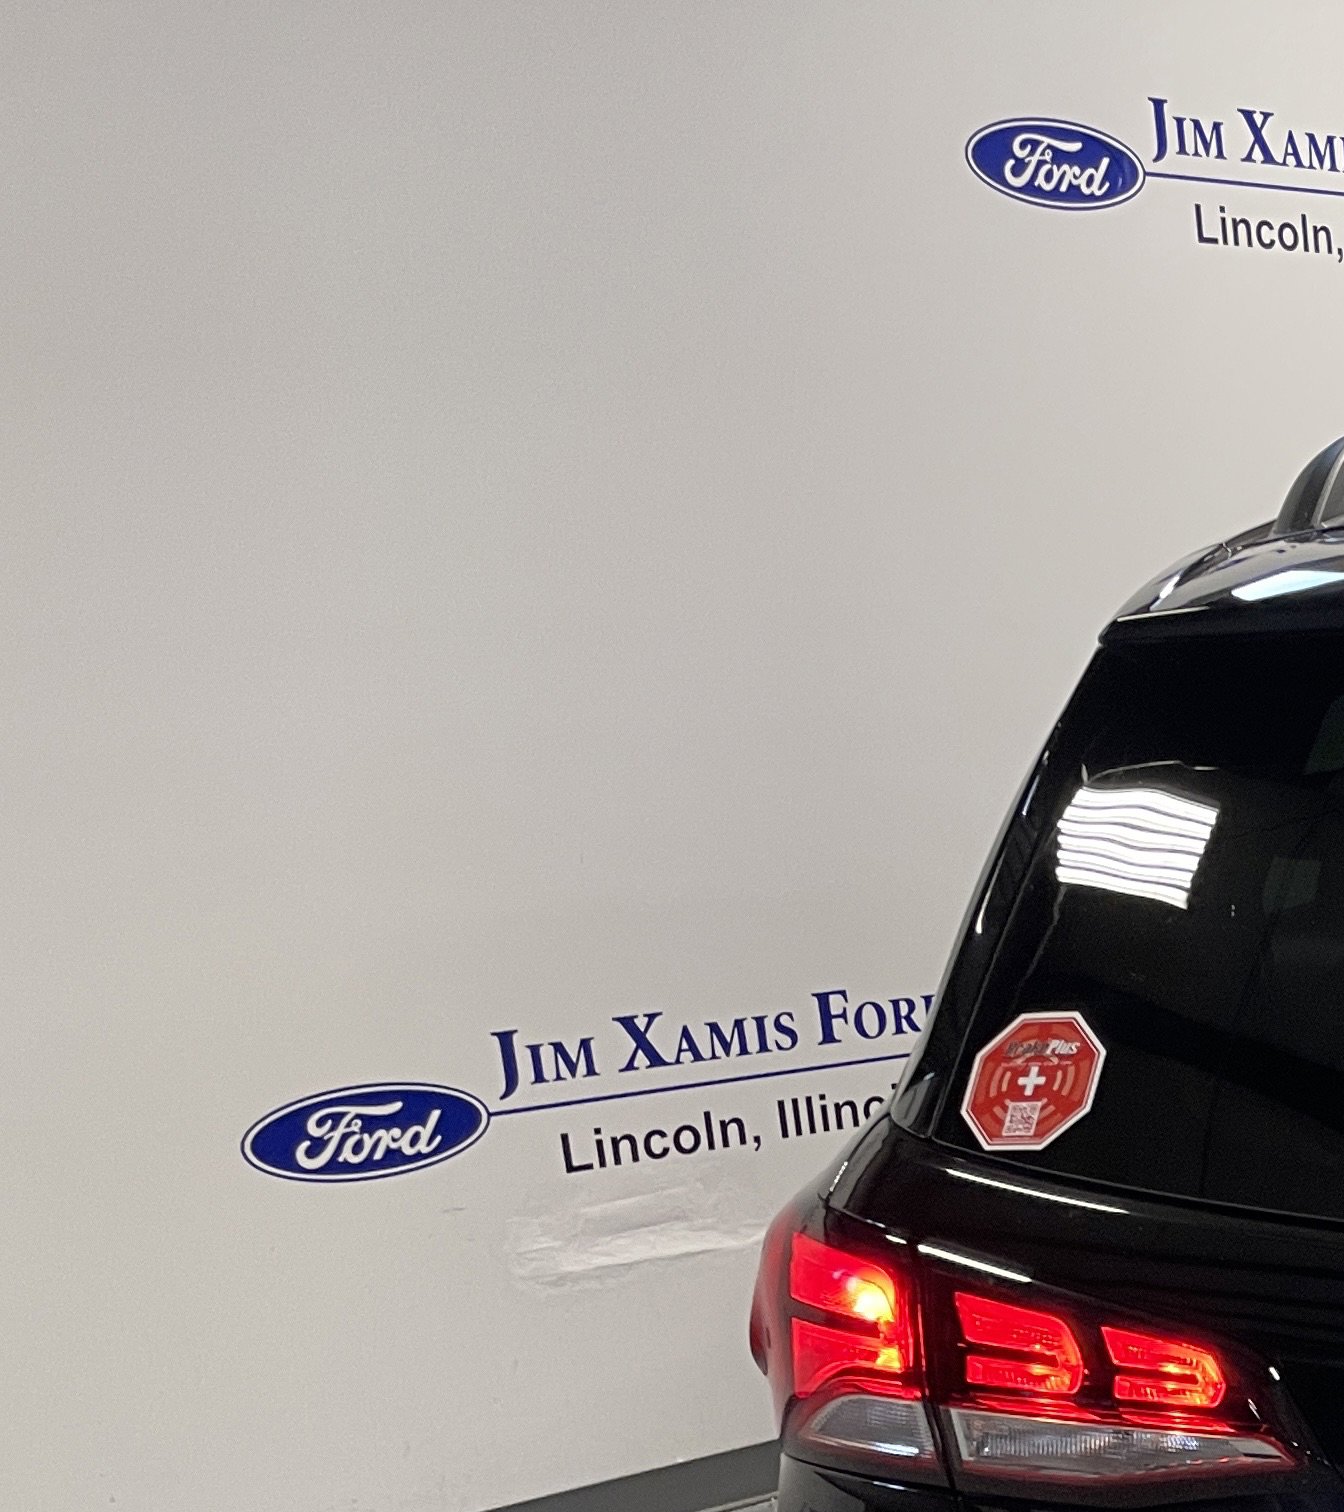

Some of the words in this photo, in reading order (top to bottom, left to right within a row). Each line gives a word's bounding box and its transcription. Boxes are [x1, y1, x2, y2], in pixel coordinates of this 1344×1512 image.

[1146, 96, 1228, 164] JIM
[1004, 132, 1111, 197] Ford
[1194, 203, 1344, 264] Lincoln,
[490, 1029, 601, 1101] JIM
[612, 1011, 799, 1073] XAMIS
[294, 1102, 443, 1170] Ford
[560, 1110, 762, 1174] Lincoln,
